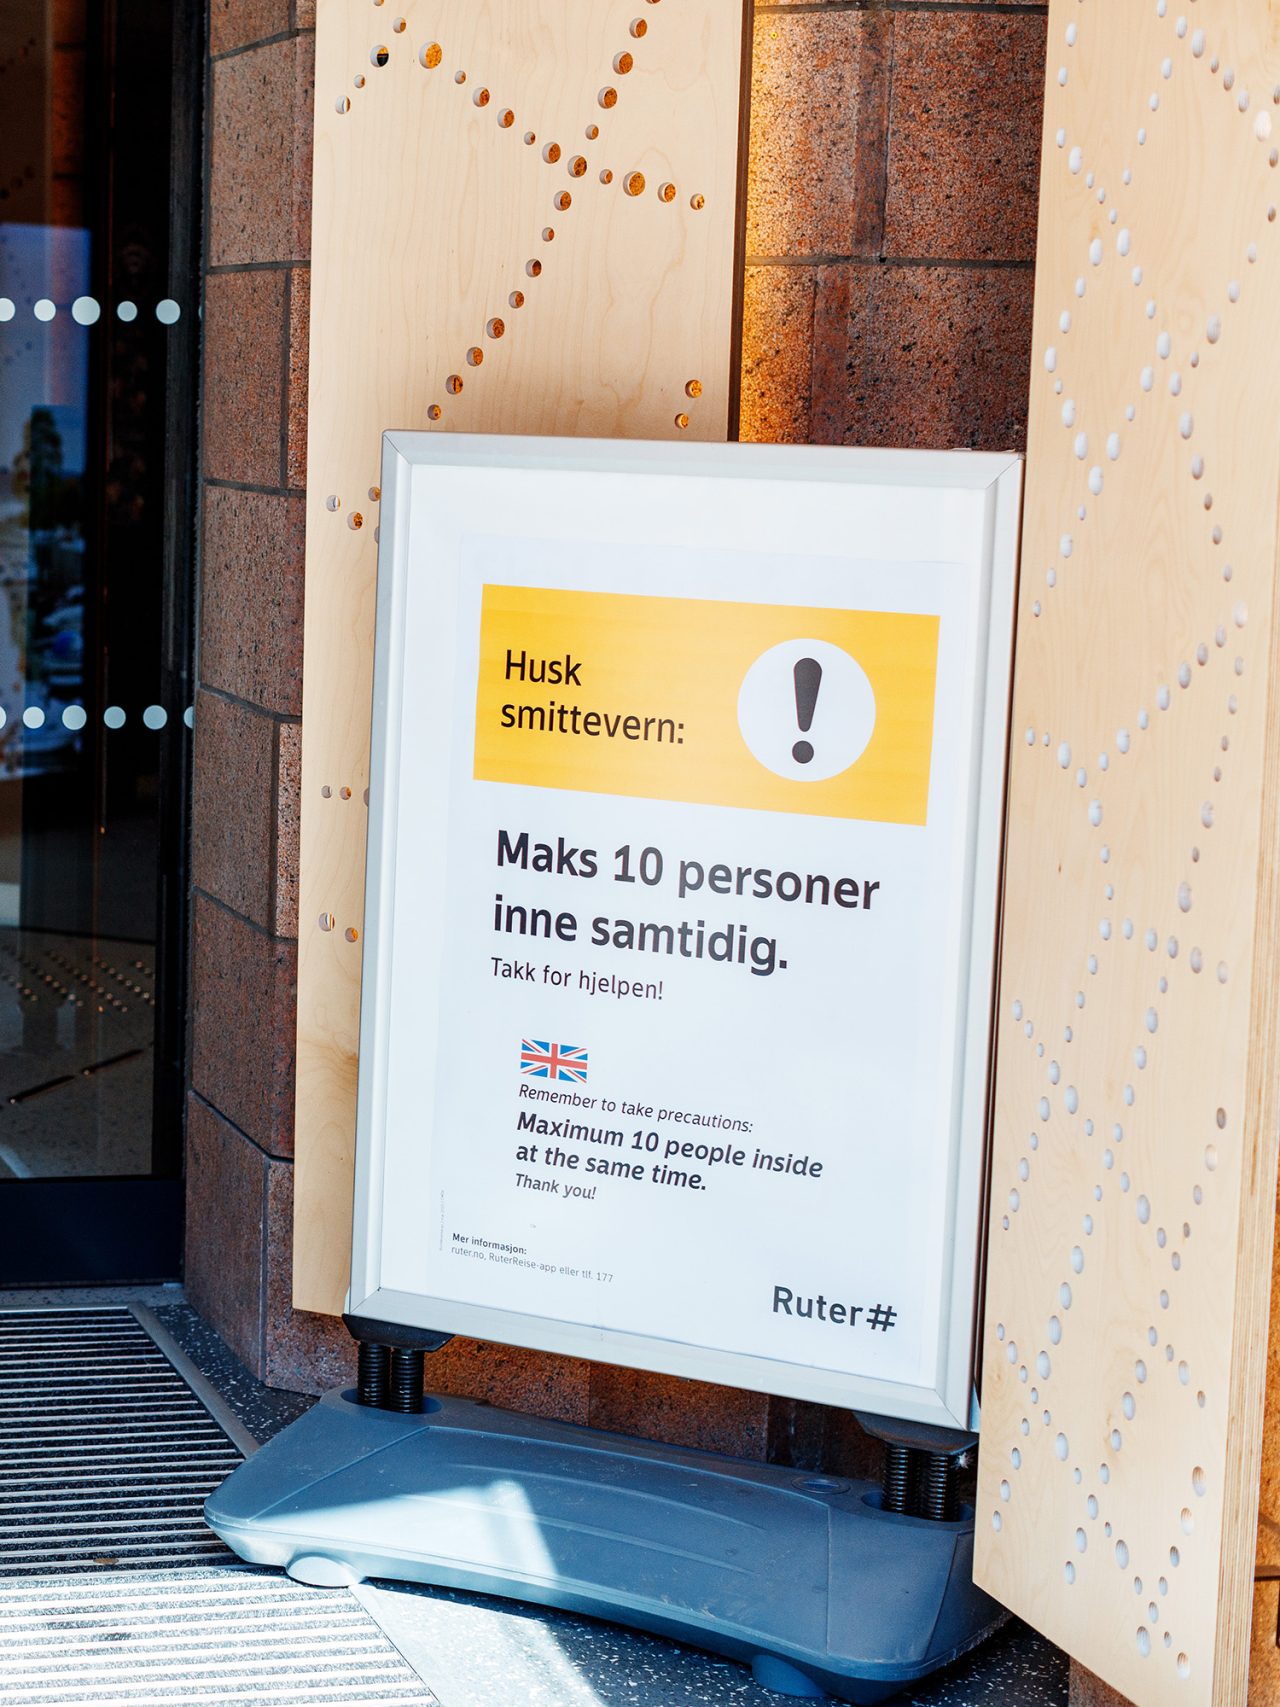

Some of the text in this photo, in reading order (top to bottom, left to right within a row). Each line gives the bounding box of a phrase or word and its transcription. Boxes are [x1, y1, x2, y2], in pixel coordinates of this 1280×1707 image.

[505, 649, 582, 687] Husk
[501, 701, 684, 745] smittevern:
[496, 829, 880, 911] Maks 10 personer
[493, 894, 788, 976] inne samtidig.
[491, 957, 664, 1000] Takk for hjelpen!
[518, 1084, 754, 1134] Remember to take precautions:
[517, 1111, 824, 1178] Maximum 10 people inside
[515, 1145, 707, 1191] at the same time.
[515, 1173, 596, 1200] Thank you!
[451, 1246, 613, 1283] ruter.no, RuterReise-app eller tlf. 177
[452, 1232, 527, 1256] Mer informasjon:
[773, 1285, 898, 1333] Ruter#
